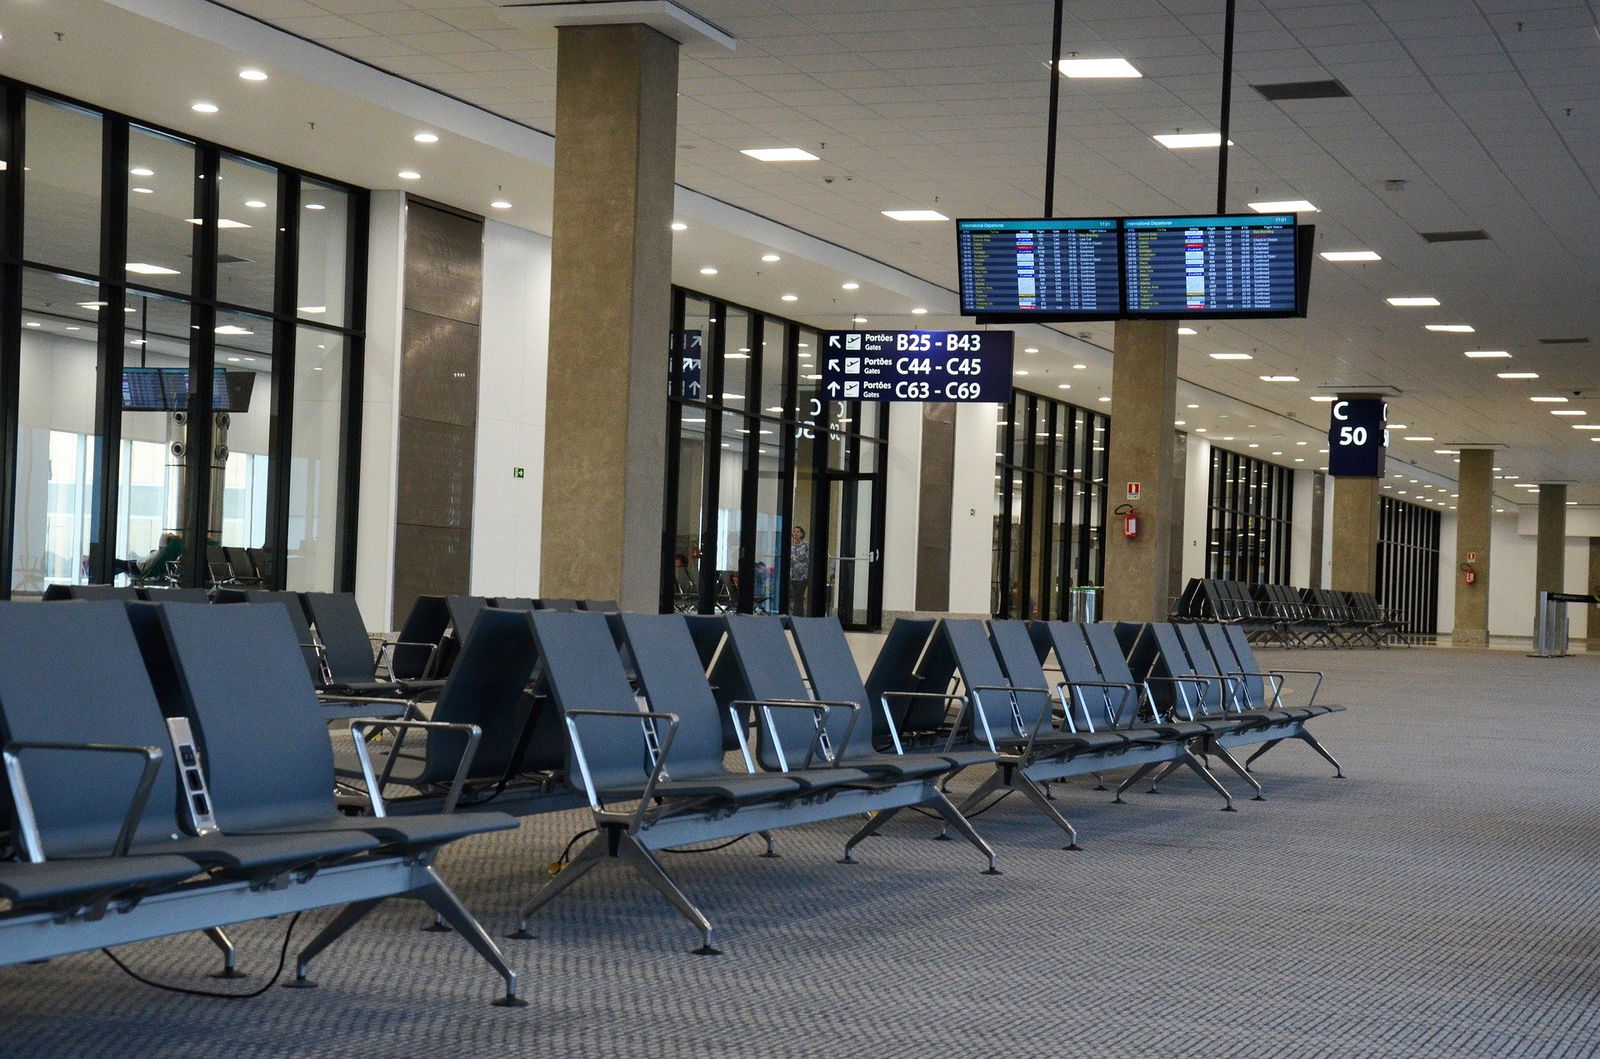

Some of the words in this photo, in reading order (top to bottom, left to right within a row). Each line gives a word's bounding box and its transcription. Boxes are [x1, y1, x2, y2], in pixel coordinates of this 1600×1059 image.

[897, 334, 930, 350] B25
[947, 334, 981, 350] B43
[864, 357, 892, 366] Portões
[896, 358, 931, 375] C44
[946, 358, 981, 375] C45
[863, 381, 891, 389] Portões
[895, 382, 929, 399] C63
[945, 382, 981, 399] C69
[1333, 401, 1348, 420] C
[1340, 426, 1367, 446] 50
